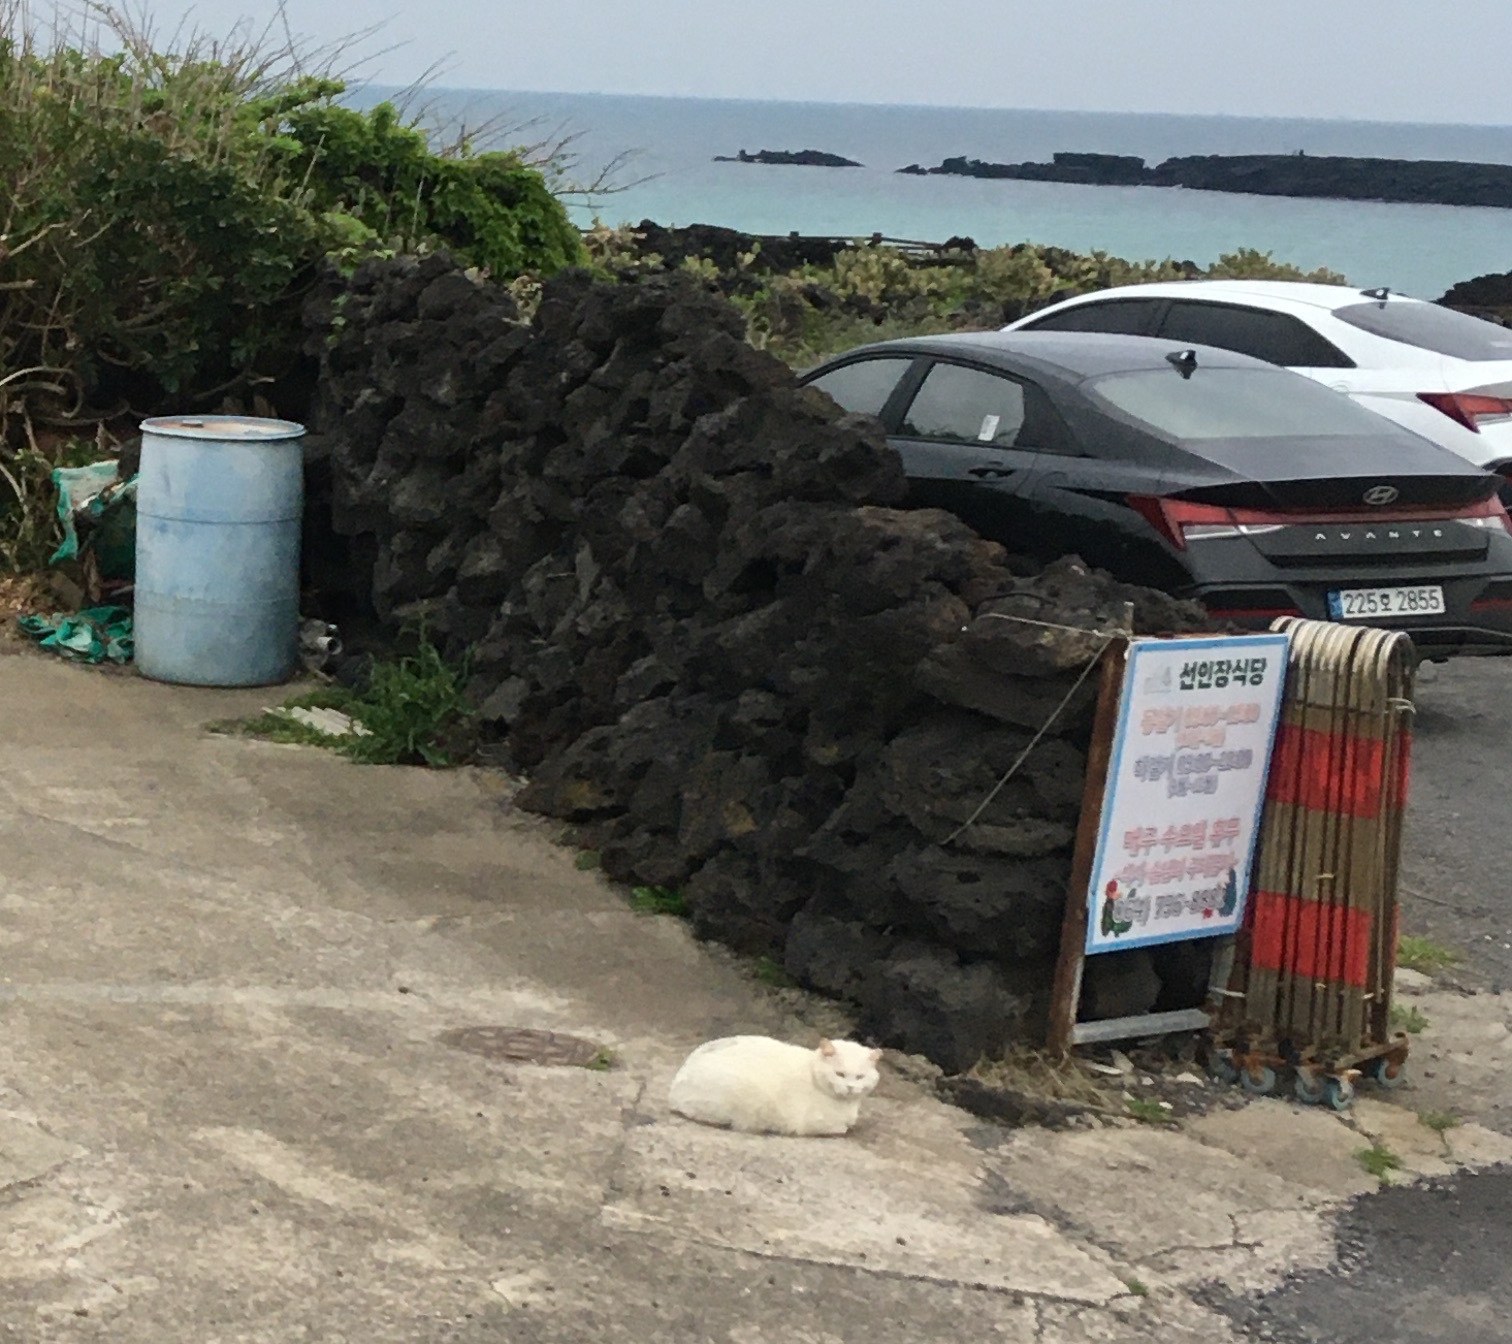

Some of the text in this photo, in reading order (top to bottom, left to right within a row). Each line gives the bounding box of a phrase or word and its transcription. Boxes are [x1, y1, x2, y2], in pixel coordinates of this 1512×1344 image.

[1315, 529, 1443, 540] AVANTE
[1396, 589, 1440, 611] 2855
[1179, 657, 1267, 691] 선인장식당
